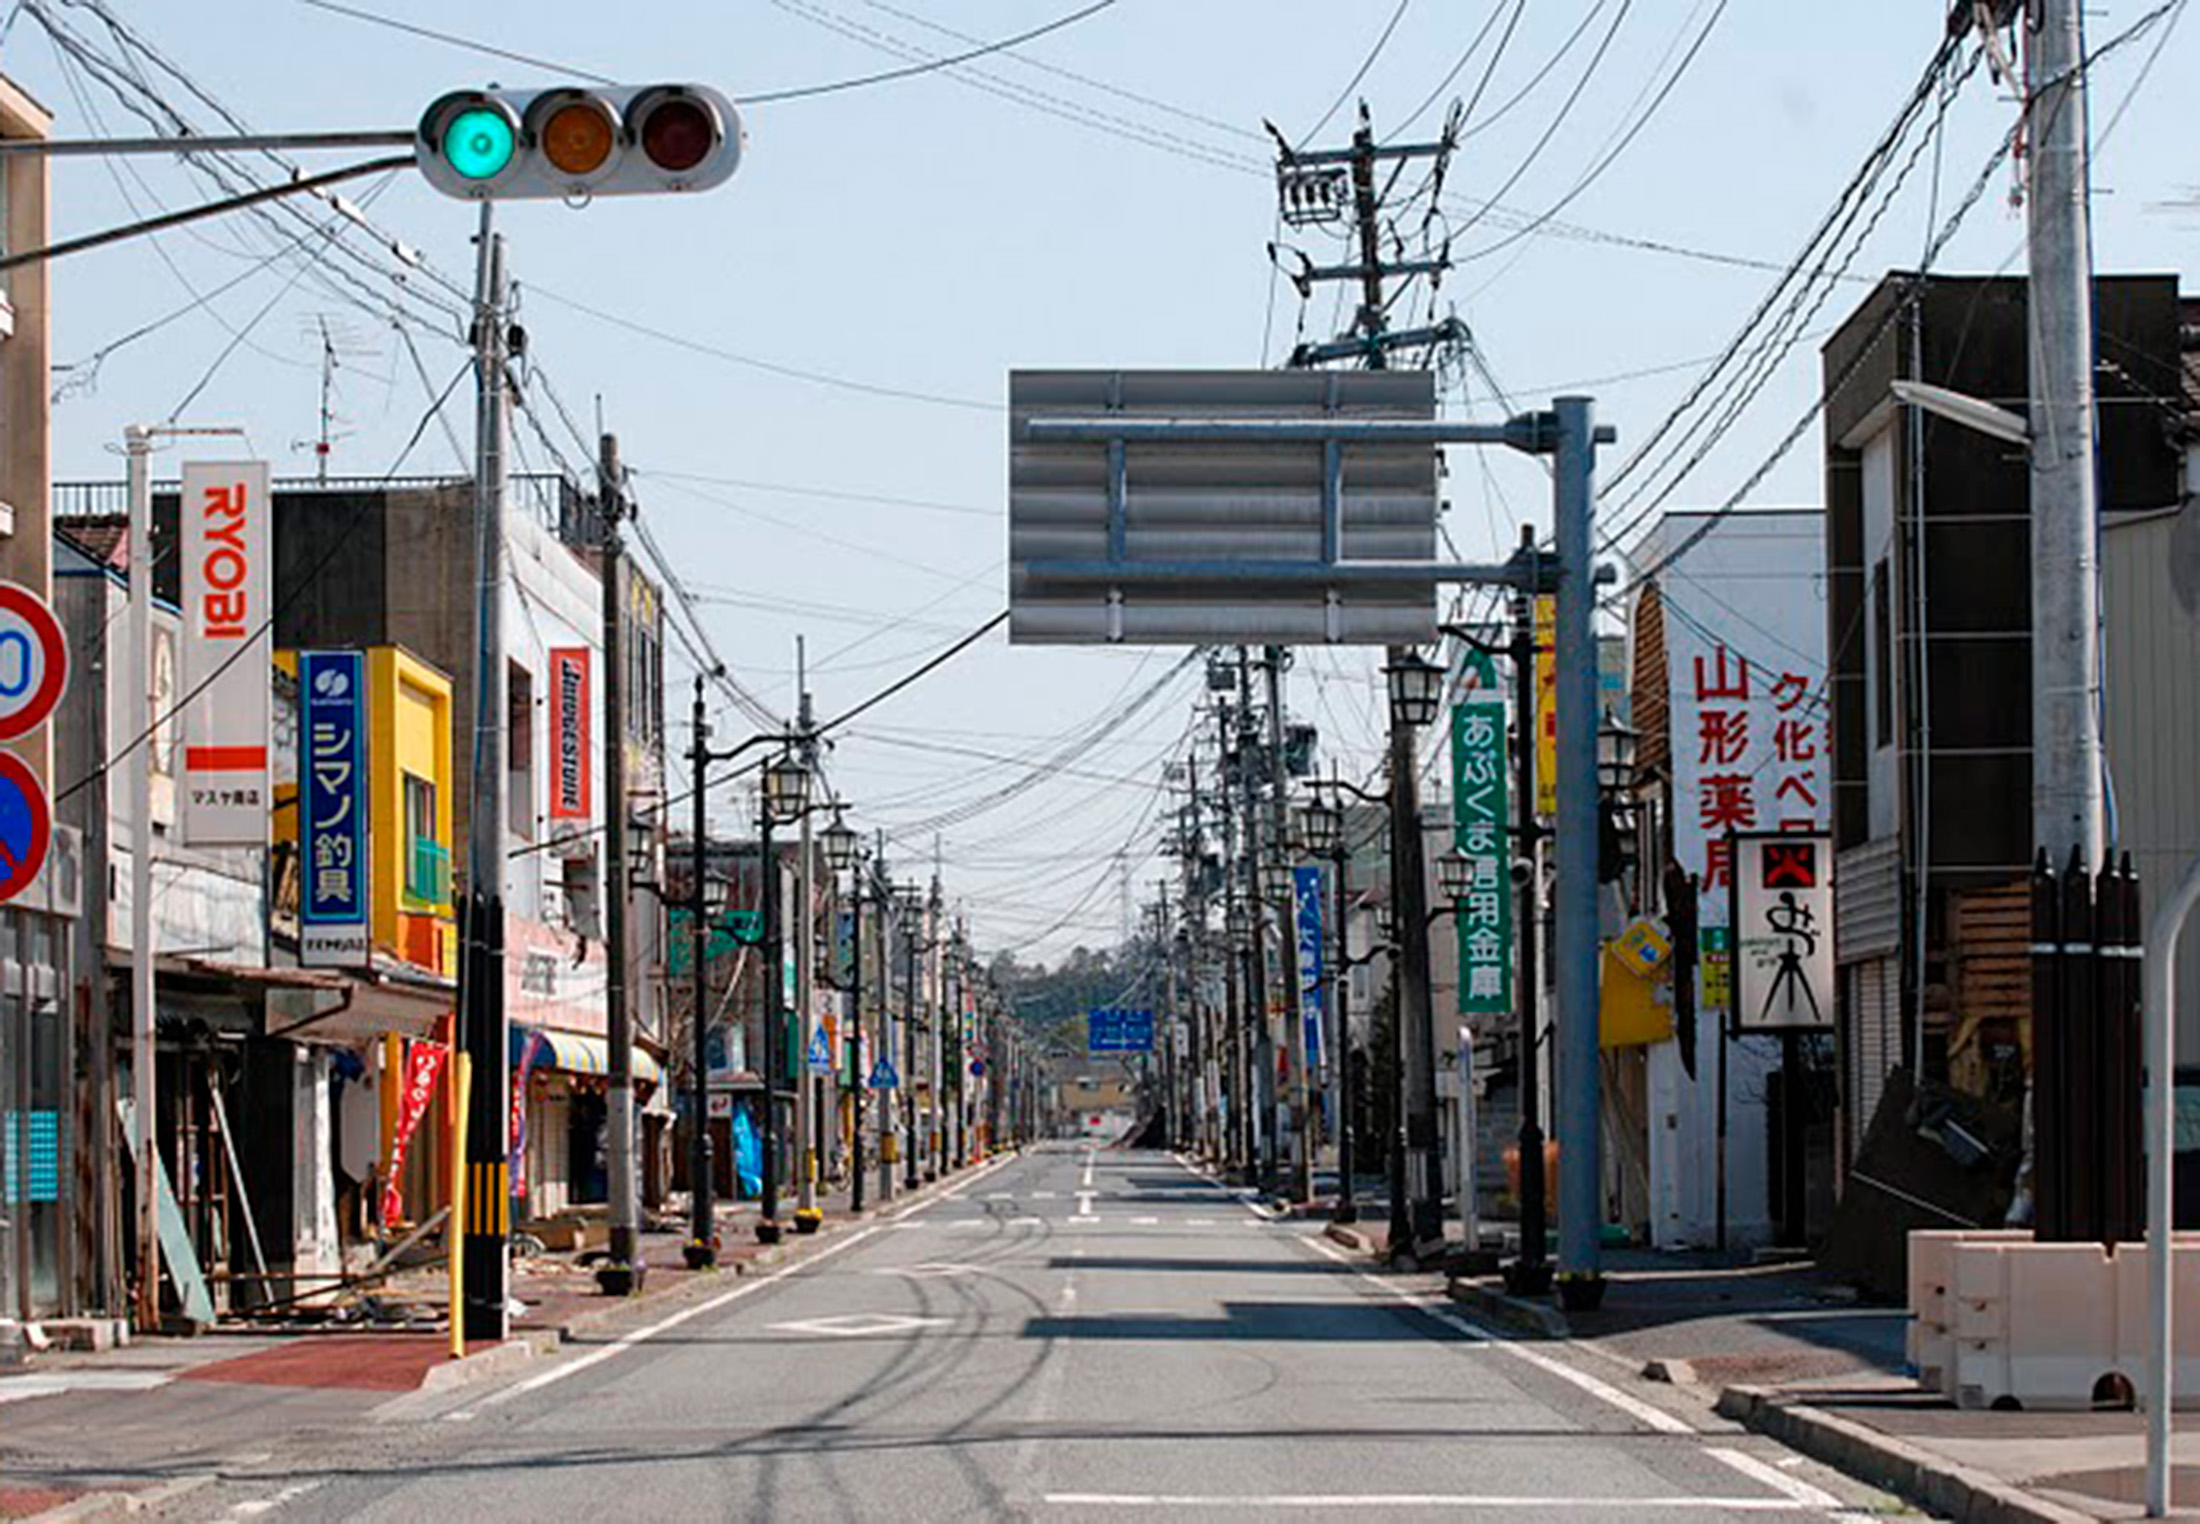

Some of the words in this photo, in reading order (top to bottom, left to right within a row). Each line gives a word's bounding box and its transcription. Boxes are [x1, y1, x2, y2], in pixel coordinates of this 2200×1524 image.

[203, 482, 247, 640] RYOBI
[313, 722, 353, 903] シマノ釣具
